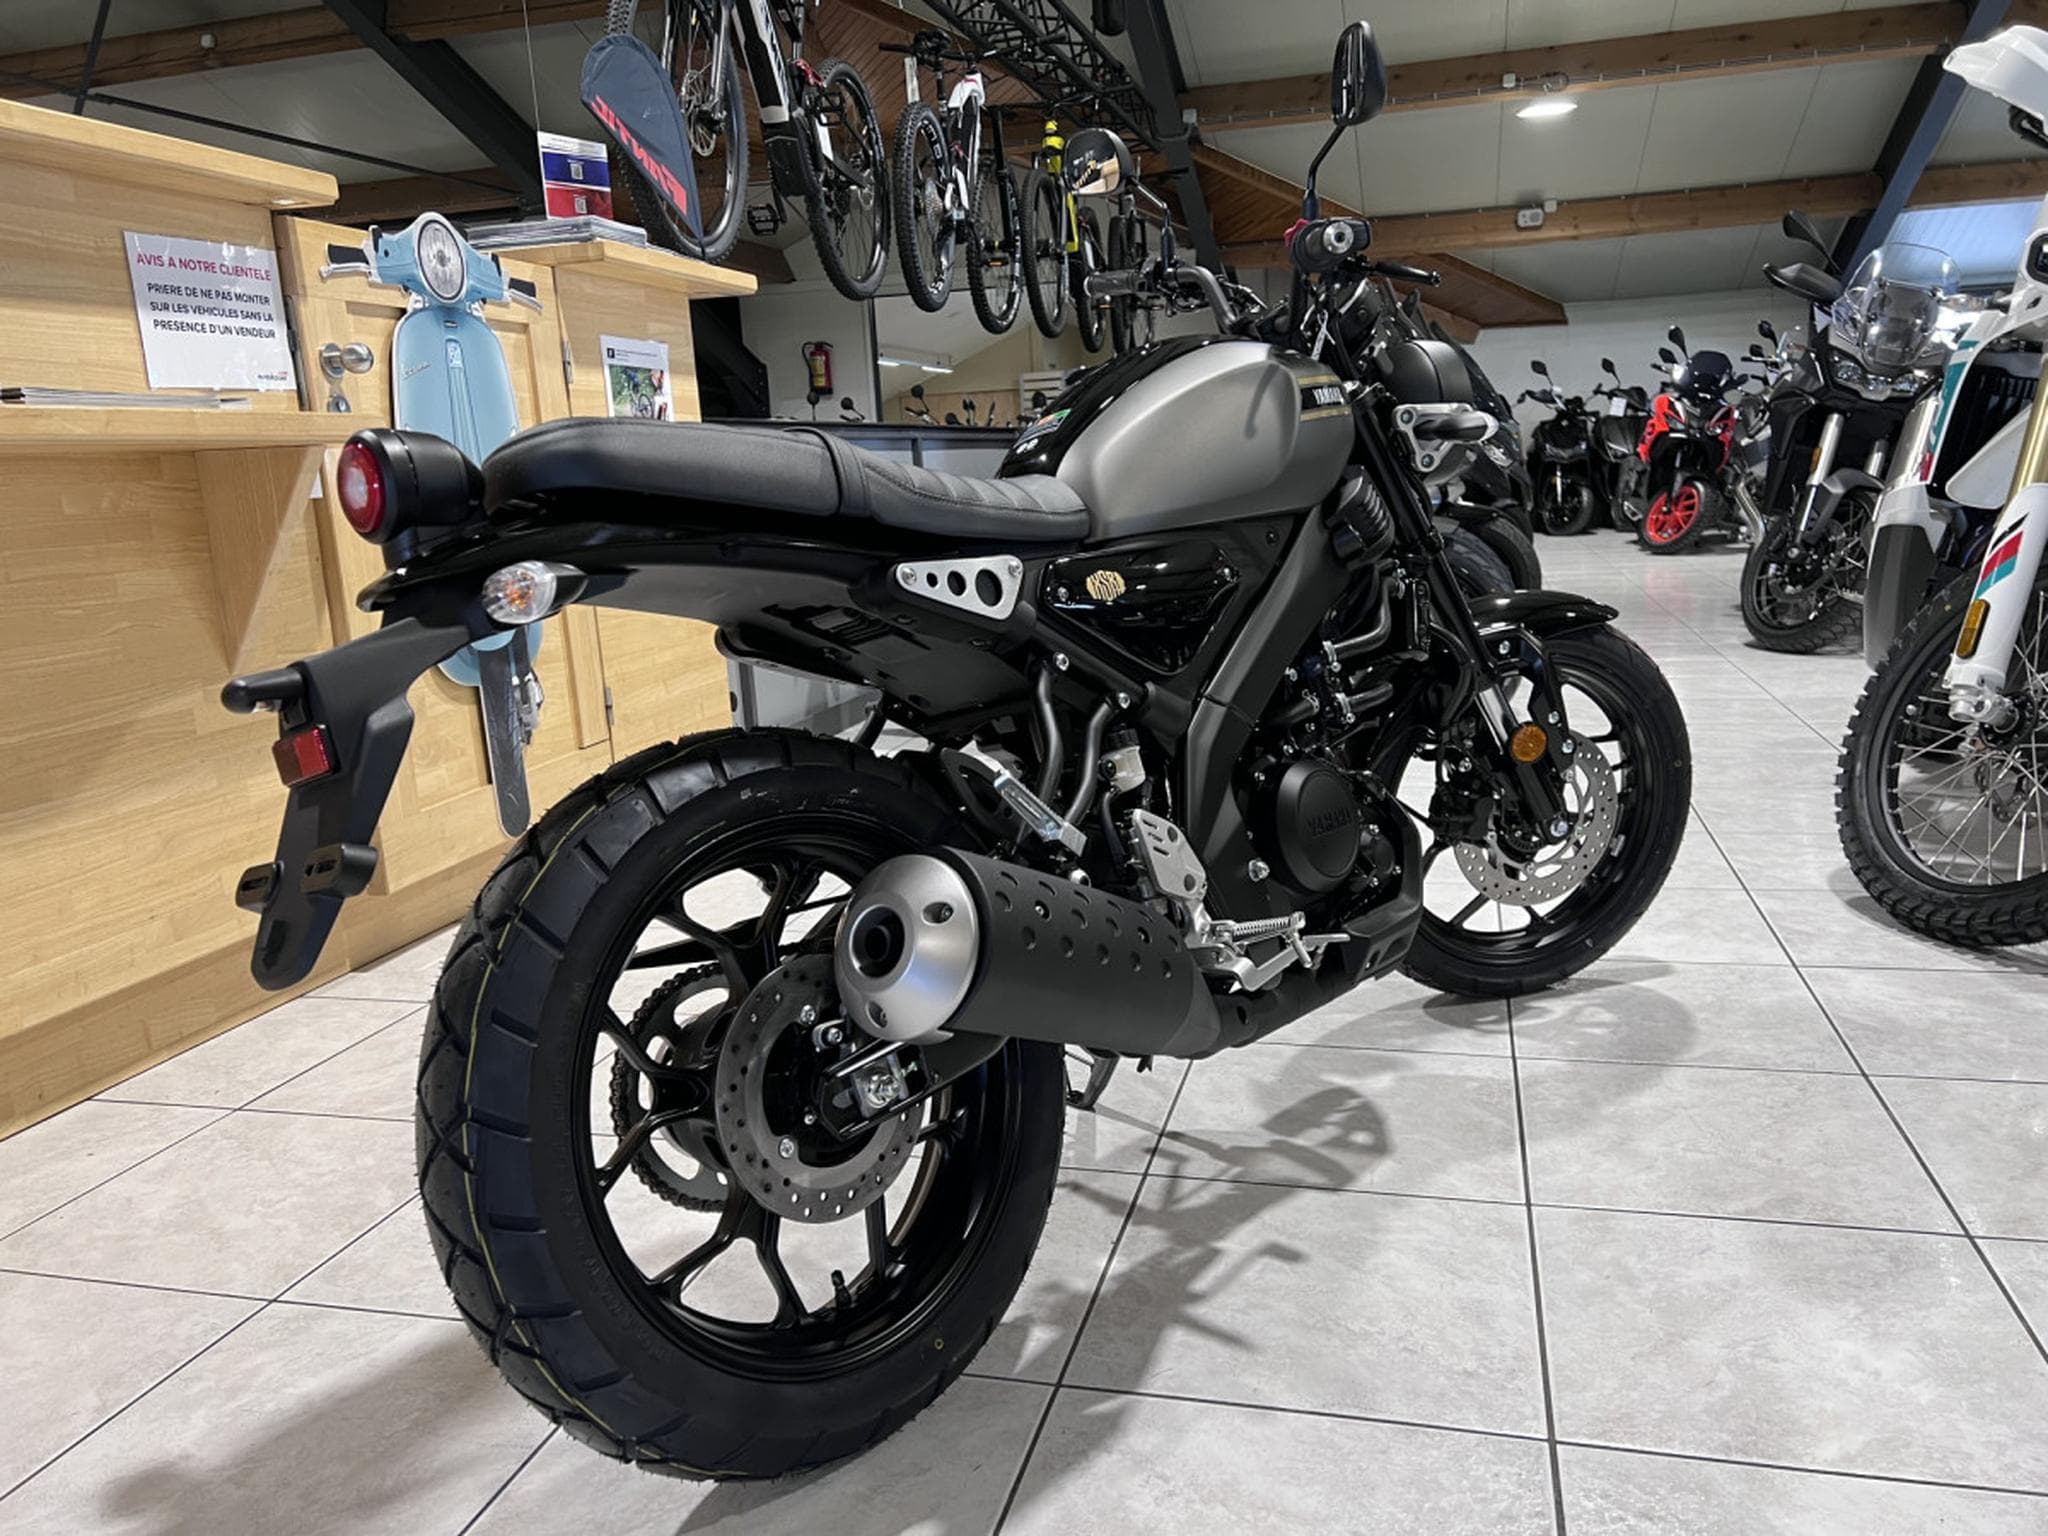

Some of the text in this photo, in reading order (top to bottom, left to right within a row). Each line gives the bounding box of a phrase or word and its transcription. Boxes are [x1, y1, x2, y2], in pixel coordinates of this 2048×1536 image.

[137, 253, 273, 281] AVIS A NOTRE CLIENTELE
[147, 283, 271, 305] PRIERE DE NE PAS MONTER
[150, 301, 274, 322] SUR LES VEHICULES SANS LA
[153, 319, 276, 339] PRESENCE D'UN VENDEUR
